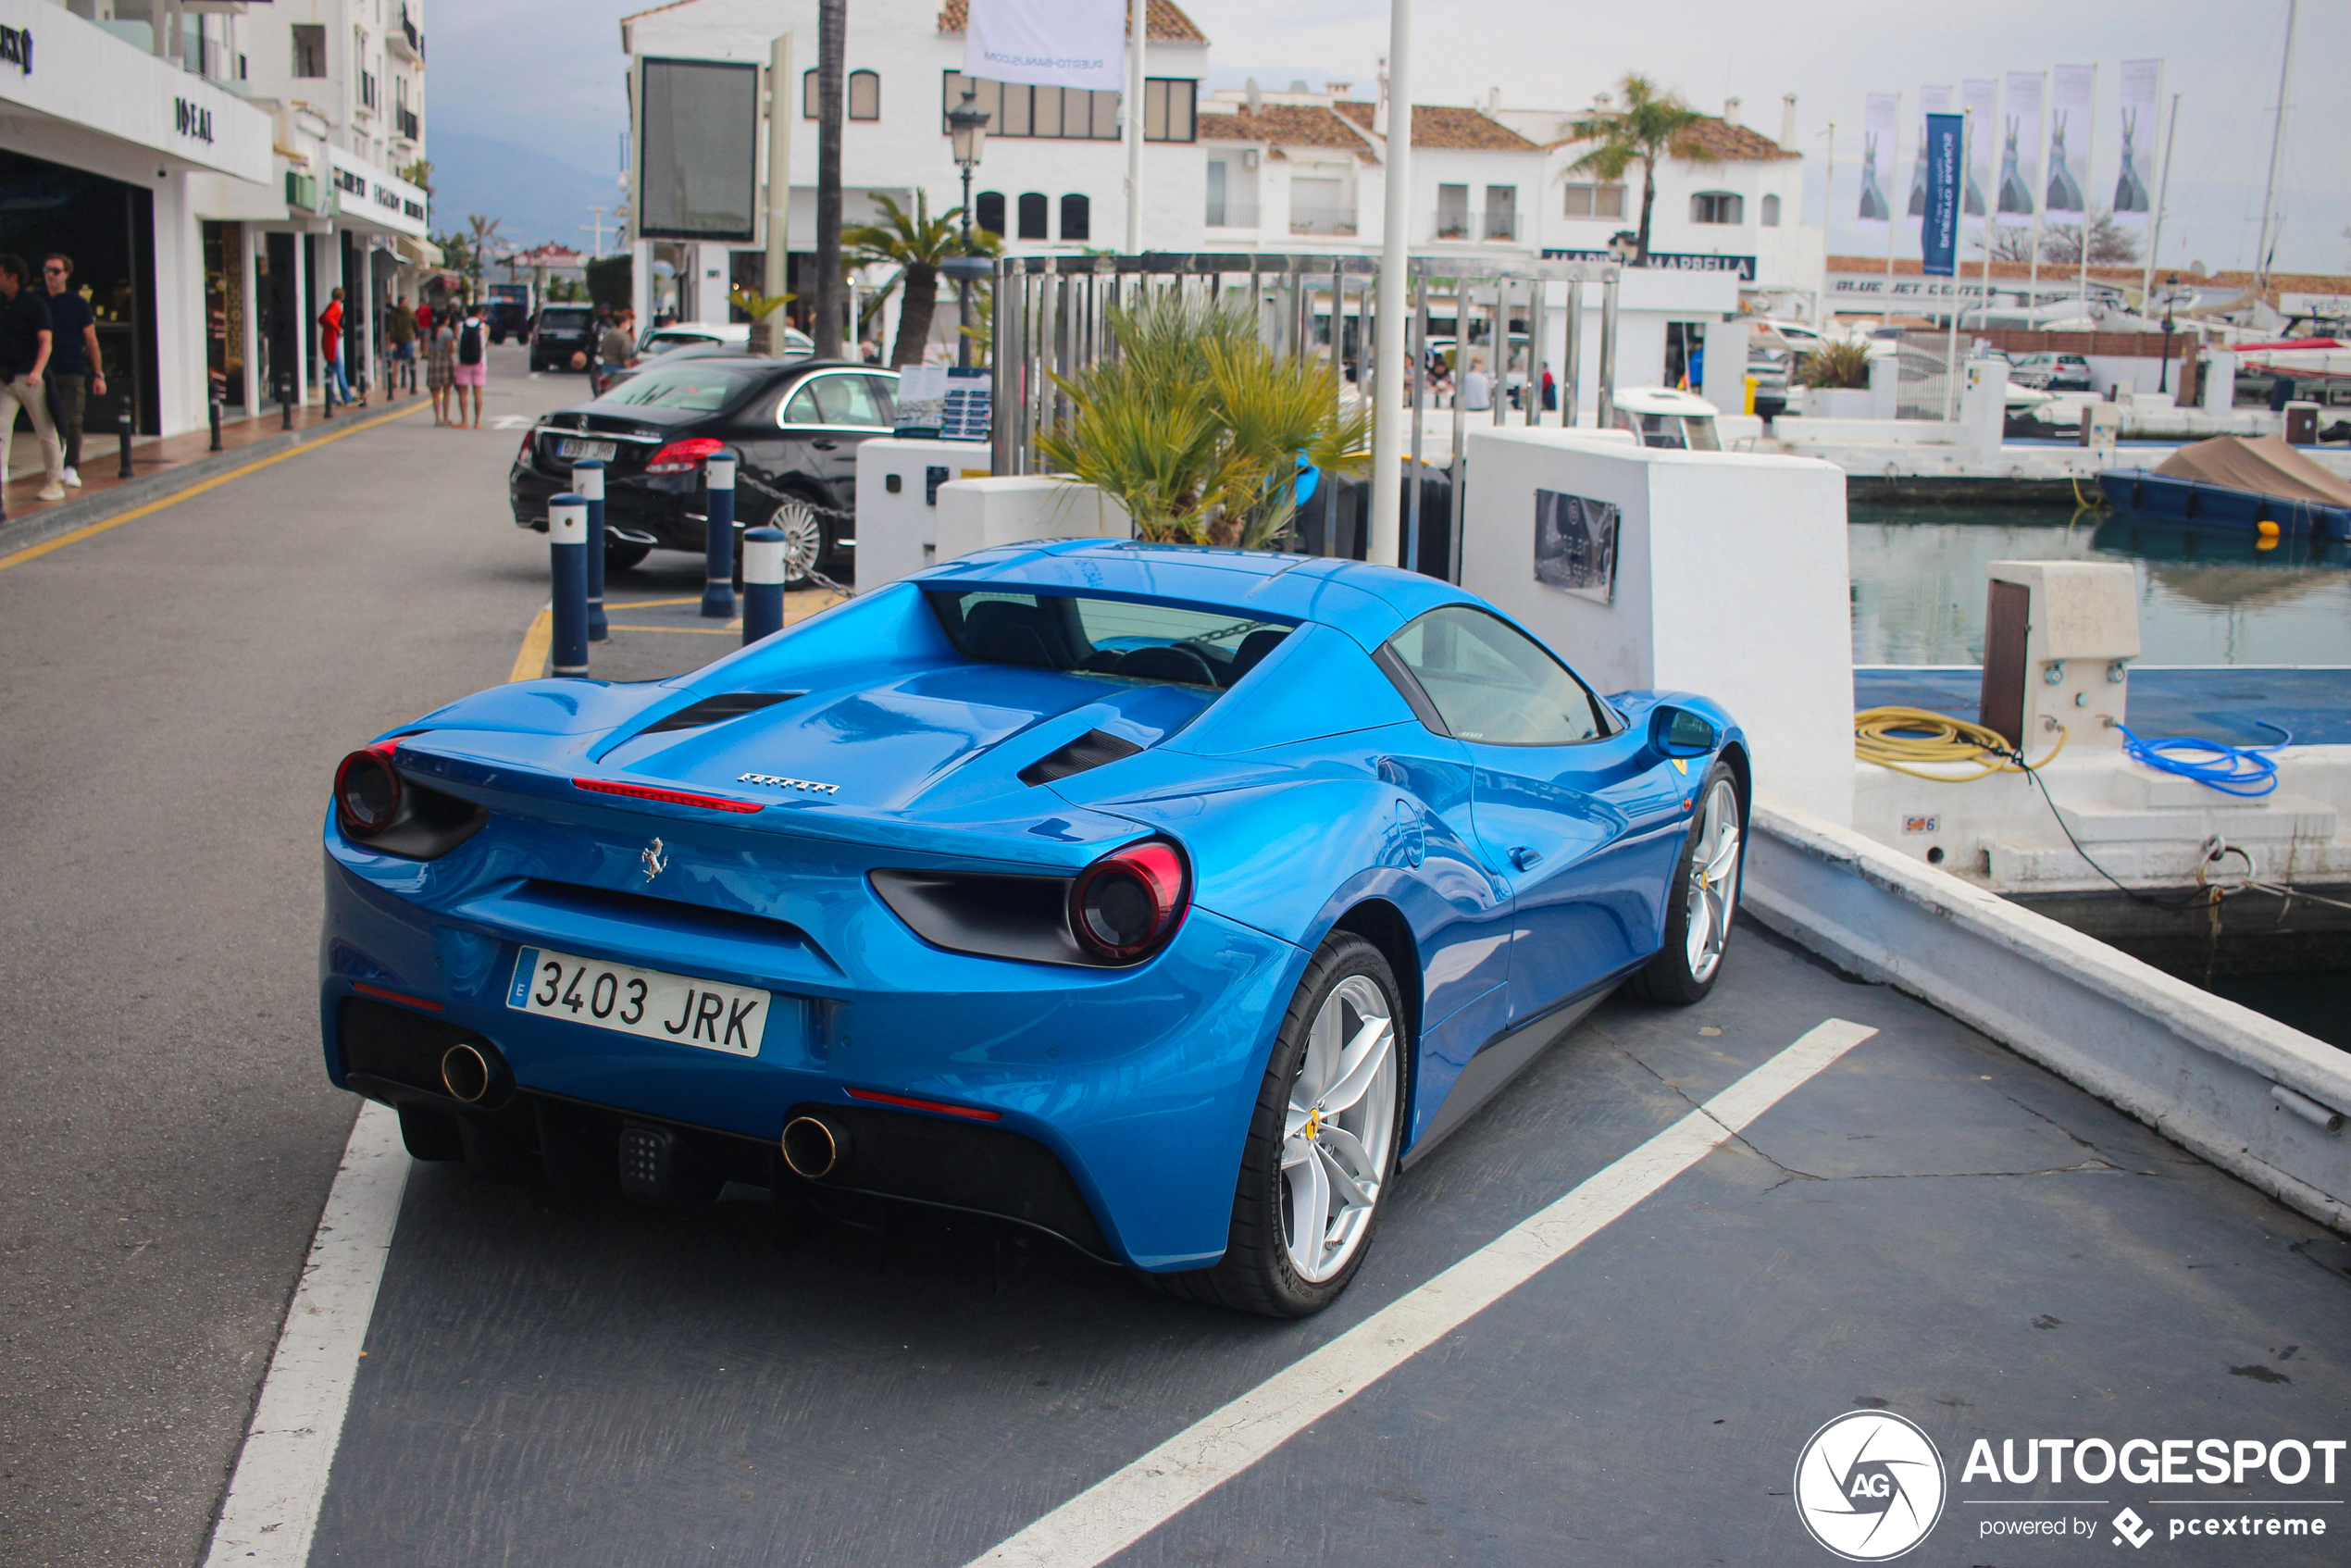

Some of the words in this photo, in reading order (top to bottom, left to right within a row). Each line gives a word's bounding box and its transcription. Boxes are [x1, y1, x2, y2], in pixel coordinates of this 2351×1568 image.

[175, 97, 214, 143] IDEAL
[1836, 280, 1885, 292] BLUE
[1891, 281, 1924, 295] JET
[516, 983, 526, 998] E
[535, 961, 649, 1026] 3403
[664, 989, 759, 1050] JRK
[1271, 1162, 1281, 1246] MICHELIN
